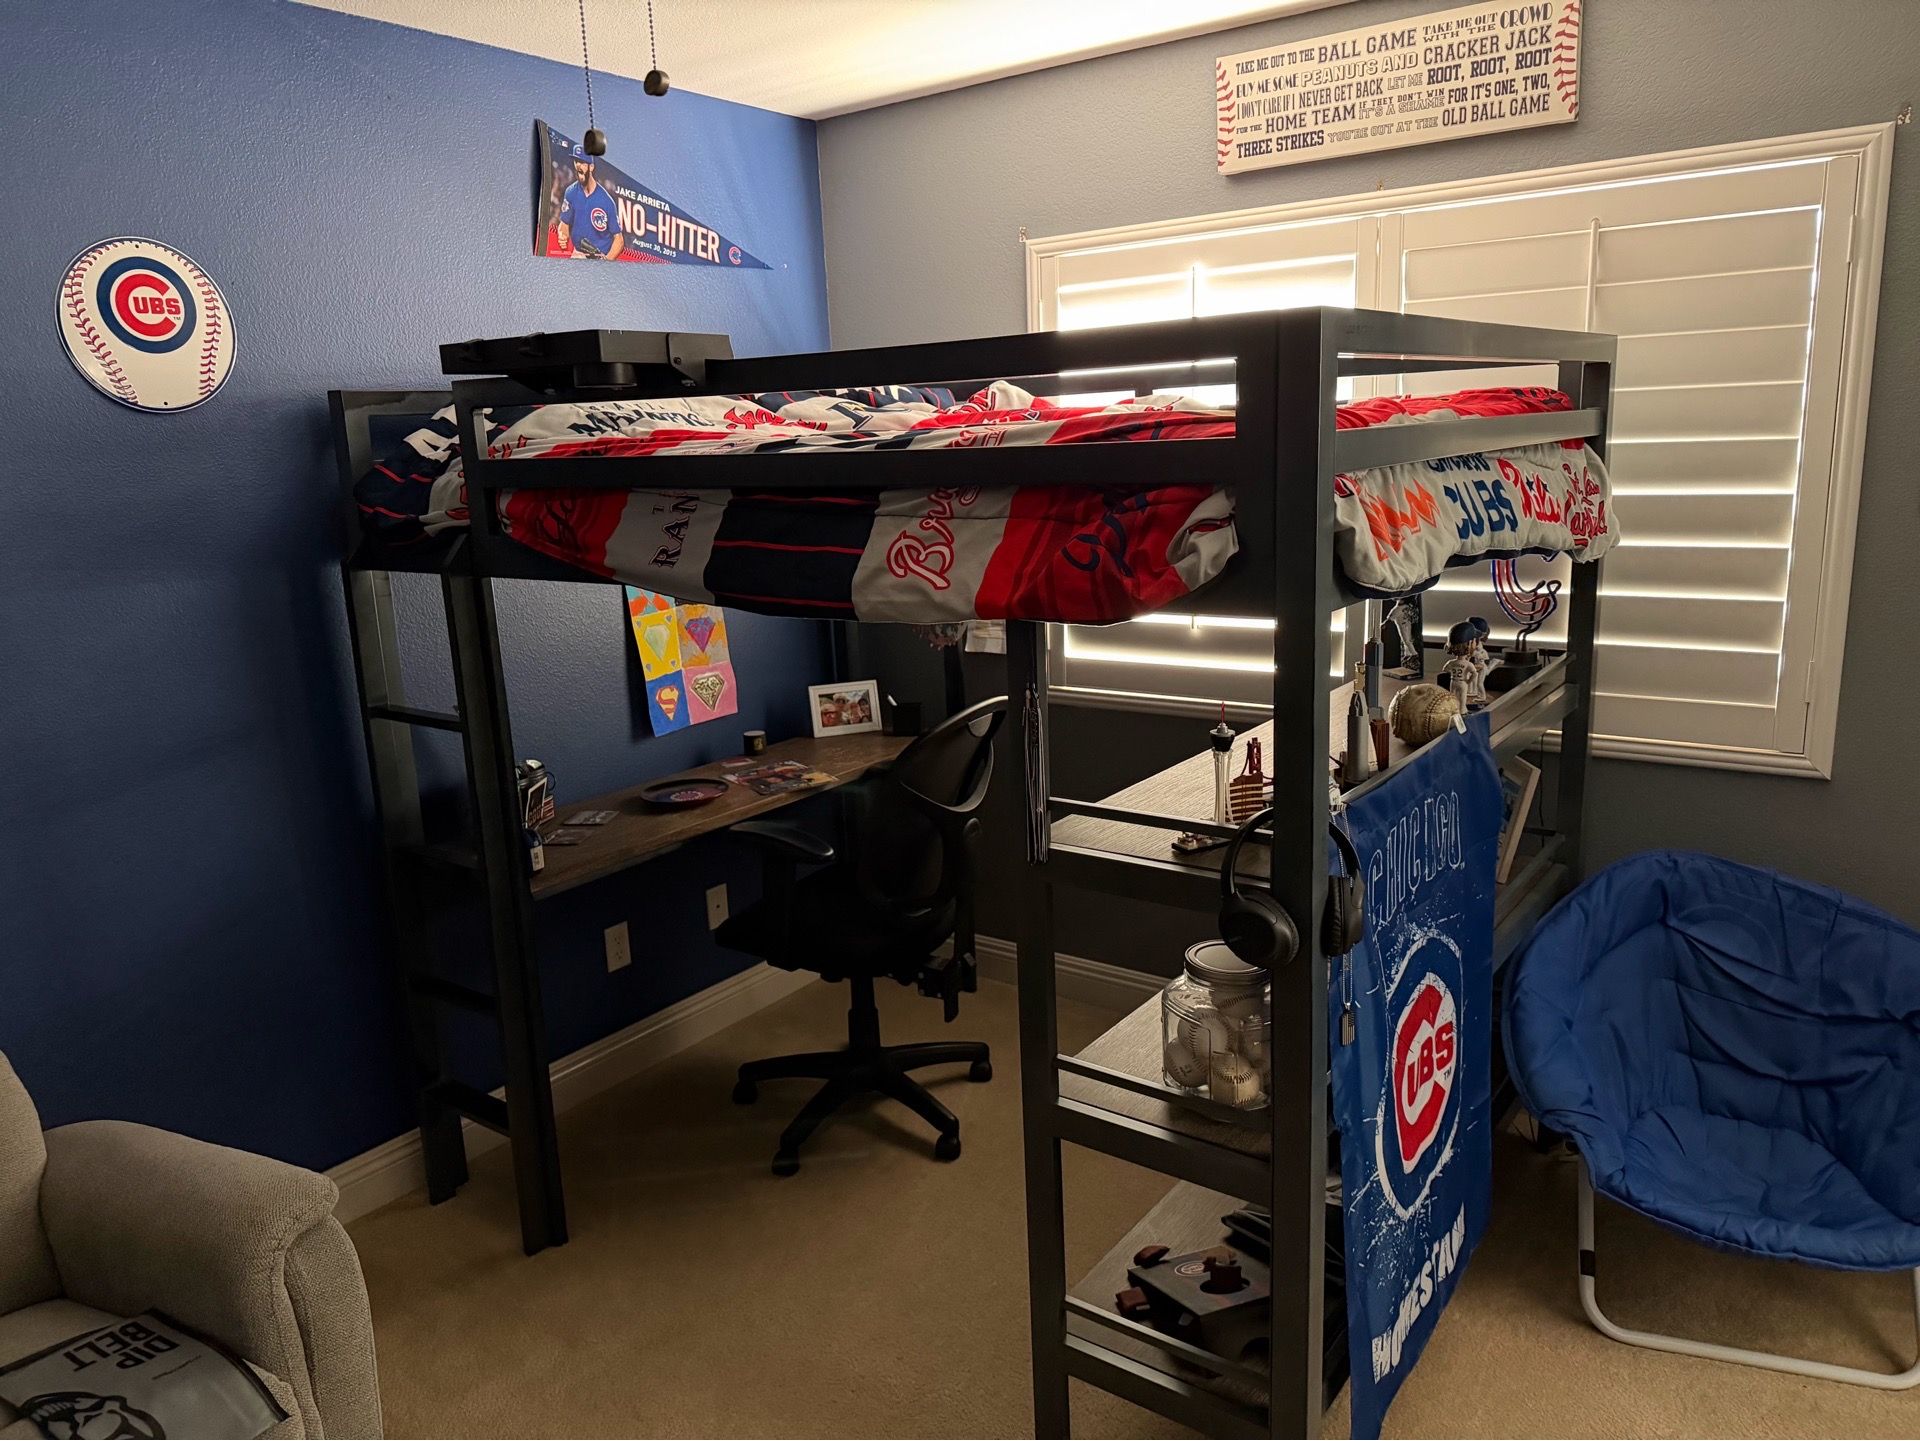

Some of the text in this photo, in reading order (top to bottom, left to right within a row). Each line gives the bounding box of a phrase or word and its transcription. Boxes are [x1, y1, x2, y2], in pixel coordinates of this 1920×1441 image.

[1423, 2, 1553, 36] TAKE ME OUT CROWD
[1423, 24, 1496, 43] WITH THE
[1236, 27, 1417, 75] TAKE ME OUT TO THE BALL GAME
[1236, 24, 1552, 98] BUY ME SOME PEANUTS AND CRACKER JACK
[1263, 96, 1282, 114] CARE
[1282, 94, 1291, 111] IF
[1299, 86, 1332, 109] NEVER
[1334, 82, 1354, 103] GET
[1356, 78, 1384, 99] BACK
[1387, 75, 1406, 91] LET
[1407, 72, 1423, 88] ME
[1427, 63, 1465, 85] ROOT,
[1470, 55, 1509, 79] ROOT,
[1515, 46, 1552, 70] ROOT
[1359, 87, 1445, 109] IF THEY DON'T WIN
[1448, 72, 1550, 105] FOR IT'S ONE, TWO,
[1236, 103, 1356, 135] FOR THE HOME TEAM
[1236, 93, 1550, 159] THREE STRIKES YOU'RE OUT AT THE OLD BALL GAME
[1358, 96, 1445, 120] IT'S A SHAME
[615, 185, 671, 212] JAKE ARRIETA
[618, 197, 720, 264] NO-HITTER
[632, 238, 652, 251] August
[115, 273, 181, 337] CUBS
[1443, 479, 1518, 539] CUBS
[1394, 984, 1453, 1162] CUBS
[63, 1321, 156, 1372] BELT
[116, 1335, 180, 1369] DIP
